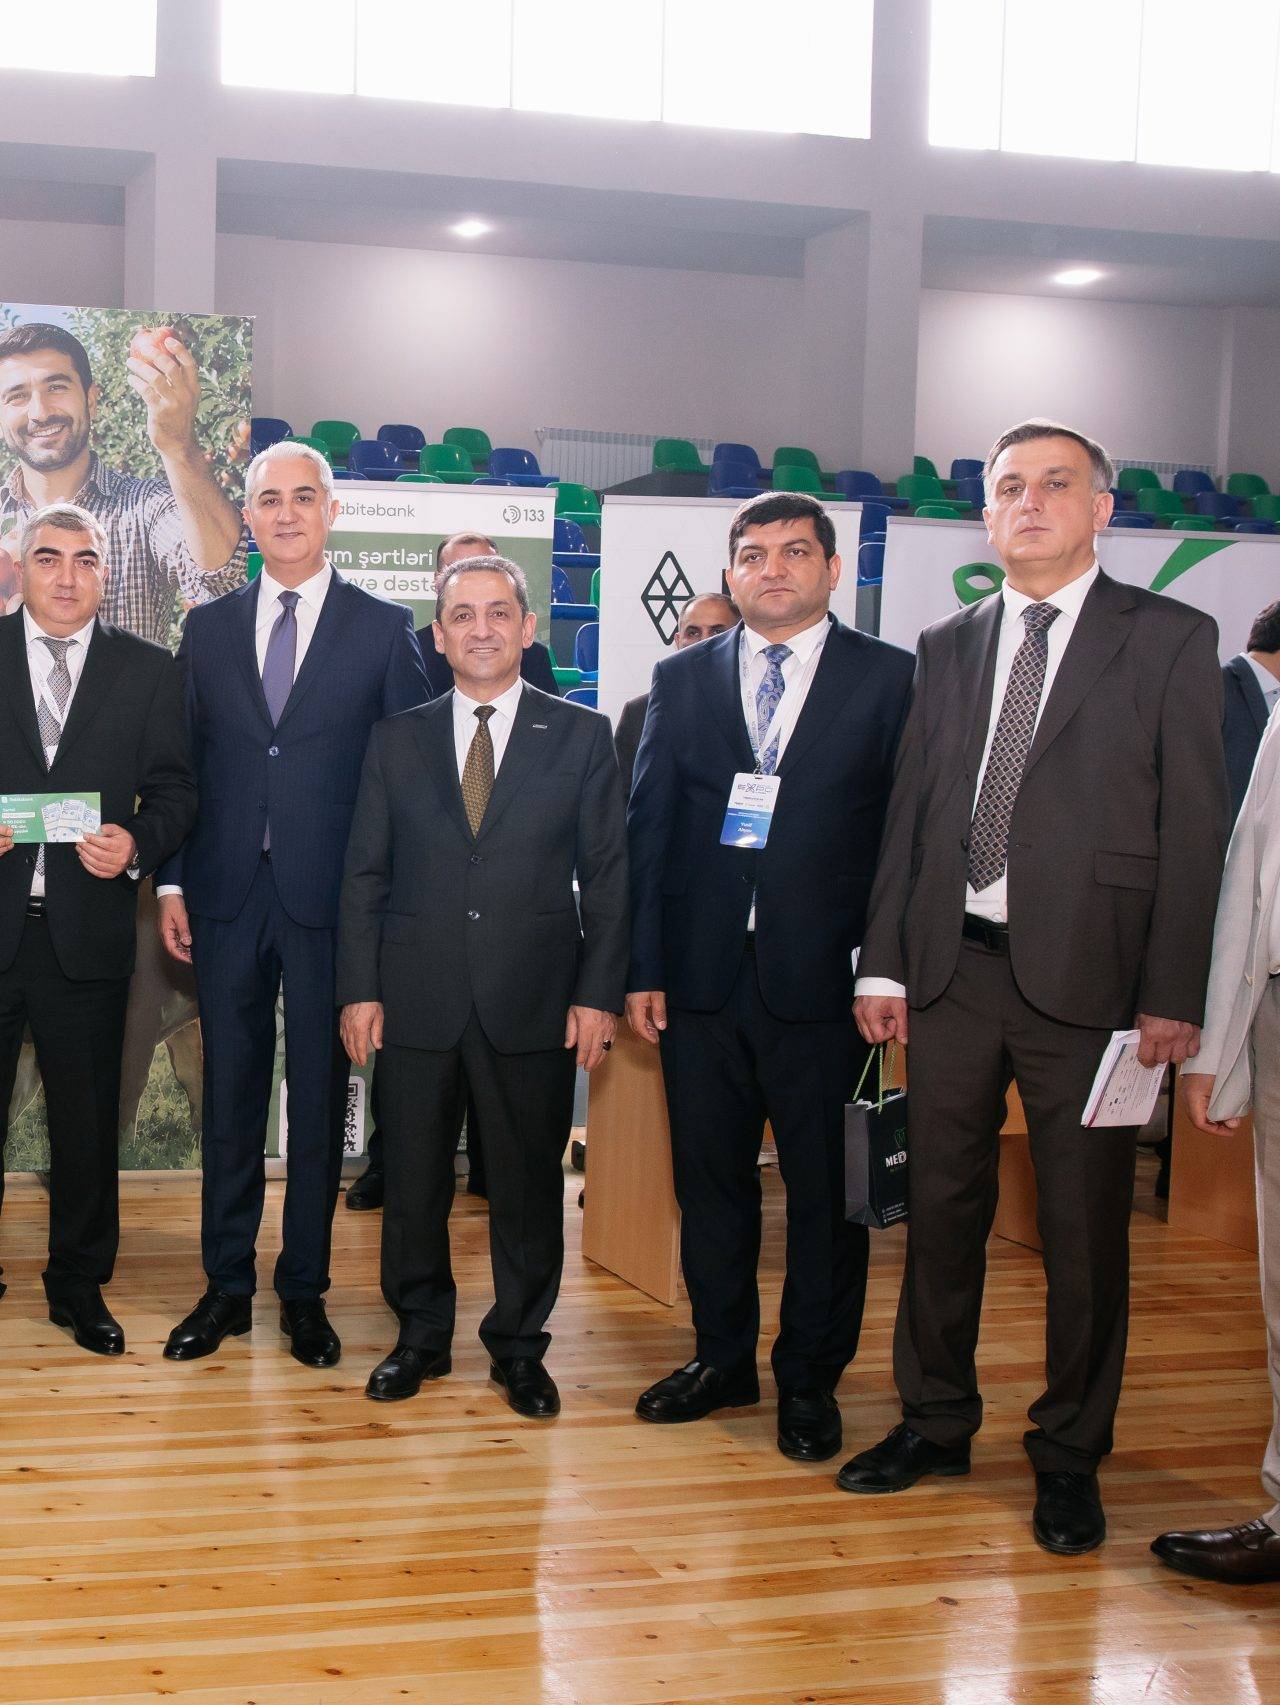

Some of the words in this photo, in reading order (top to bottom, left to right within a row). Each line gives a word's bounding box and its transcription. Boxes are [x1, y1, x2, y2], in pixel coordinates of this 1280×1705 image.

[338, 502, 416, 518] abitəbank
[523, 509, 545, 522] 133
[358, 548, 433, 569] şərtləri
[885, 1150, 907, 1168] MED
